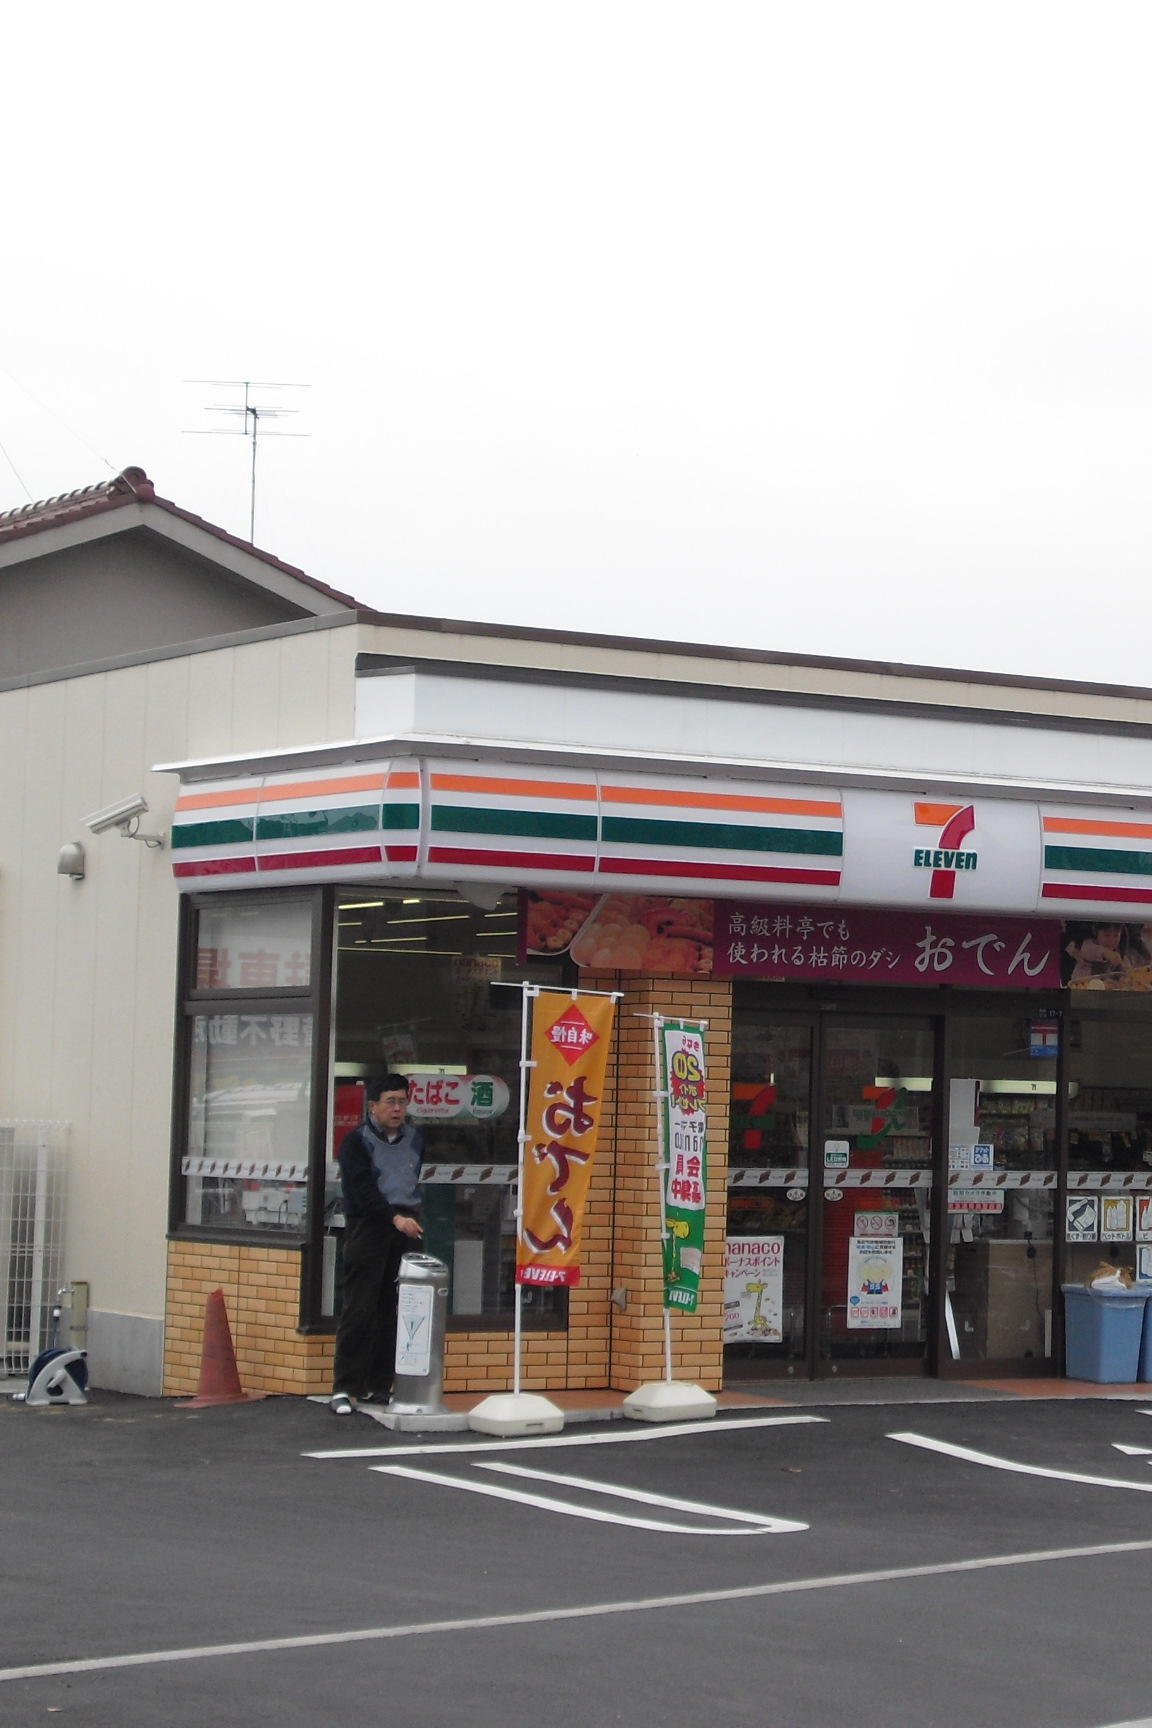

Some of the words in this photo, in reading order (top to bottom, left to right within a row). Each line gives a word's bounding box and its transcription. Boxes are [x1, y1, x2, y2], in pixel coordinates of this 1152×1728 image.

[913, 801, 976, 899] 7
[913, 848, 978, 870] ELEVEN
[728, 912, 850, 941] 高級料亭でも
[727, 942, 901, 970] 使われる枯節のダシ
[914, 925, 1050, 976] おでん
[407, 1079, 460, 1106] たばこ
[470, 1081, 494, 1107] 酒
